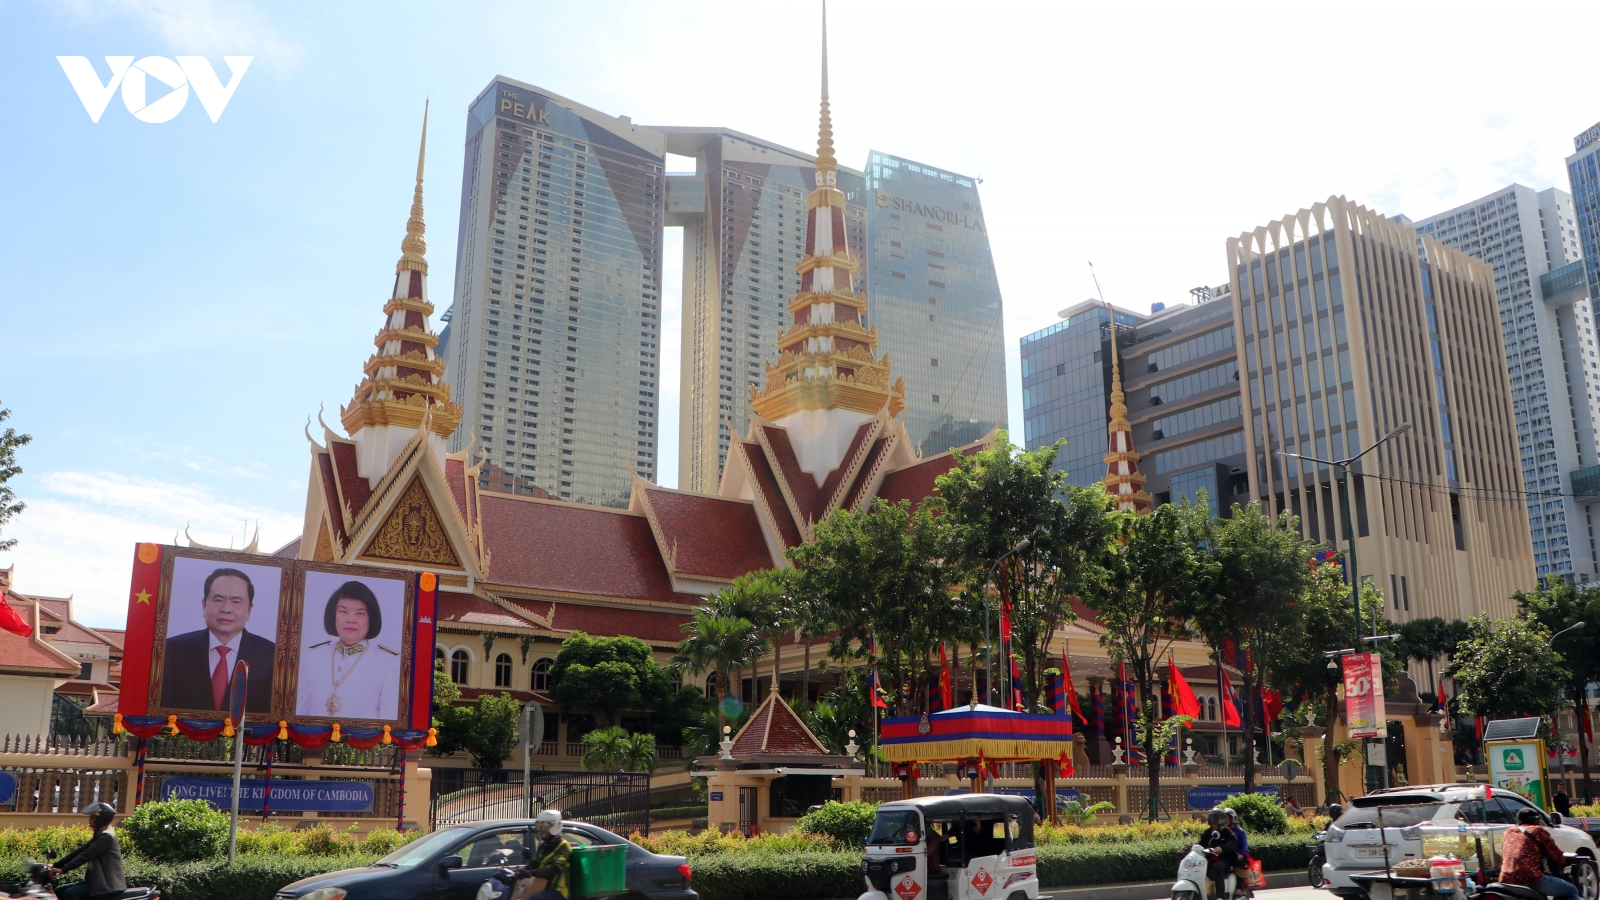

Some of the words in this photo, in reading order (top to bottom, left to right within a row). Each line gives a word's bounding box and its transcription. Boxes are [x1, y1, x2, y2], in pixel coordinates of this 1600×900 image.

[502, 90, 519, 100] THE
[501, 99, 550, 126] PEAK
[892, 197, 982, 232] SHANGRI-LA
[166, 784, 197, 797] LONG
[199, 786, 227, 798] LIVE!
[302, 788, 316, 801] OF
[317, 788, 369, 801] CAMBODIA
